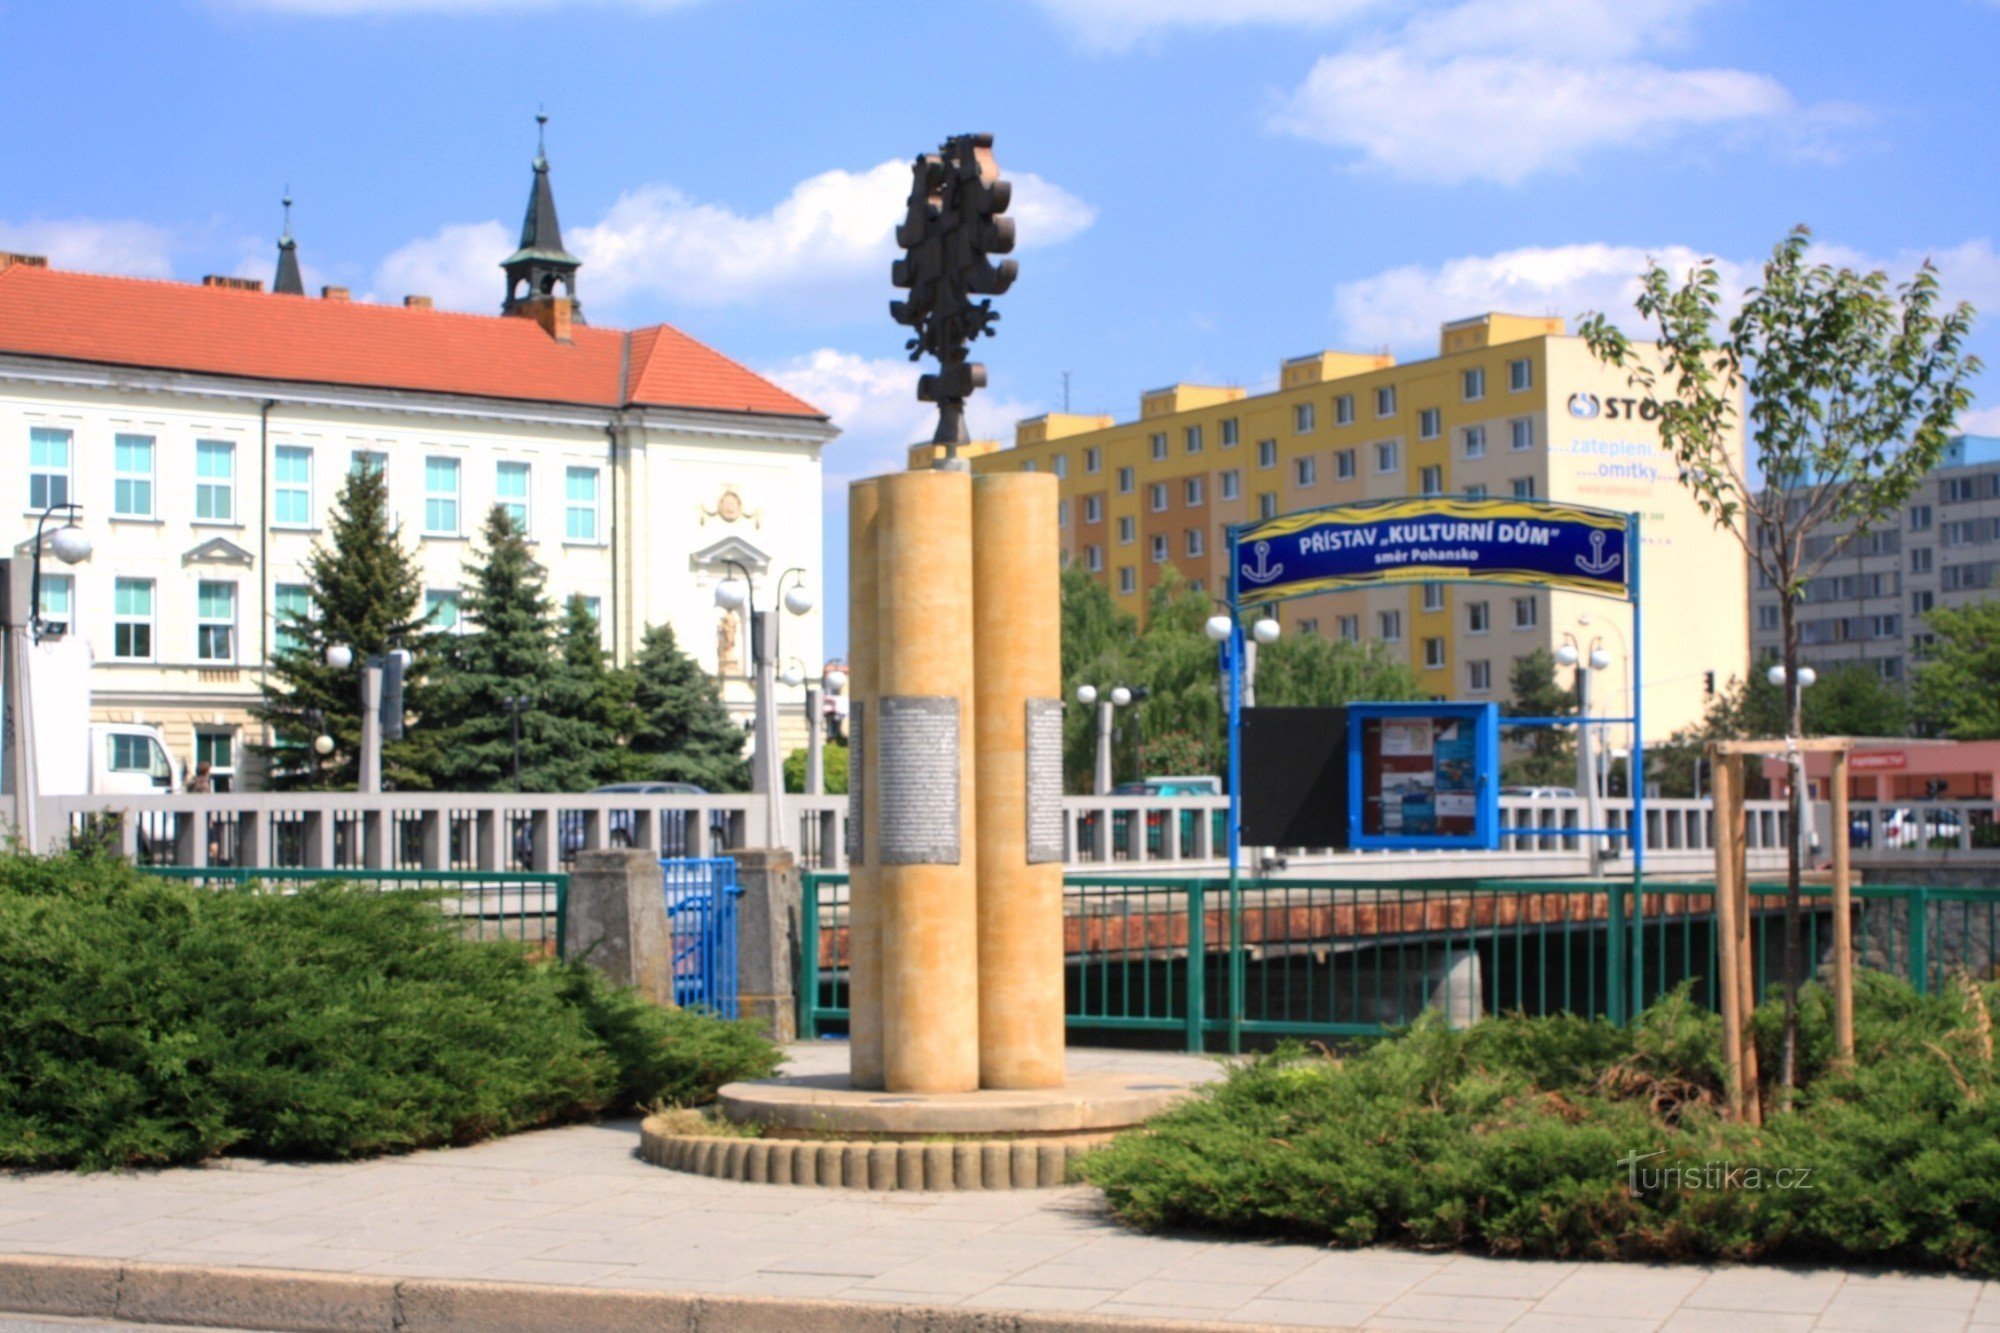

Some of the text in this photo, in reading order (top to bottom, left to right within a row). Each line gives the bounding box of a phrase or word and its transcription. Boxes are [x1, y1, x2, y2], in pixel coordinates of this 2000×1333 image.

[1299, 527, 1378, 555] PŘÍSTAV
[1374, 547, 1480, 564] směr Pohansko
